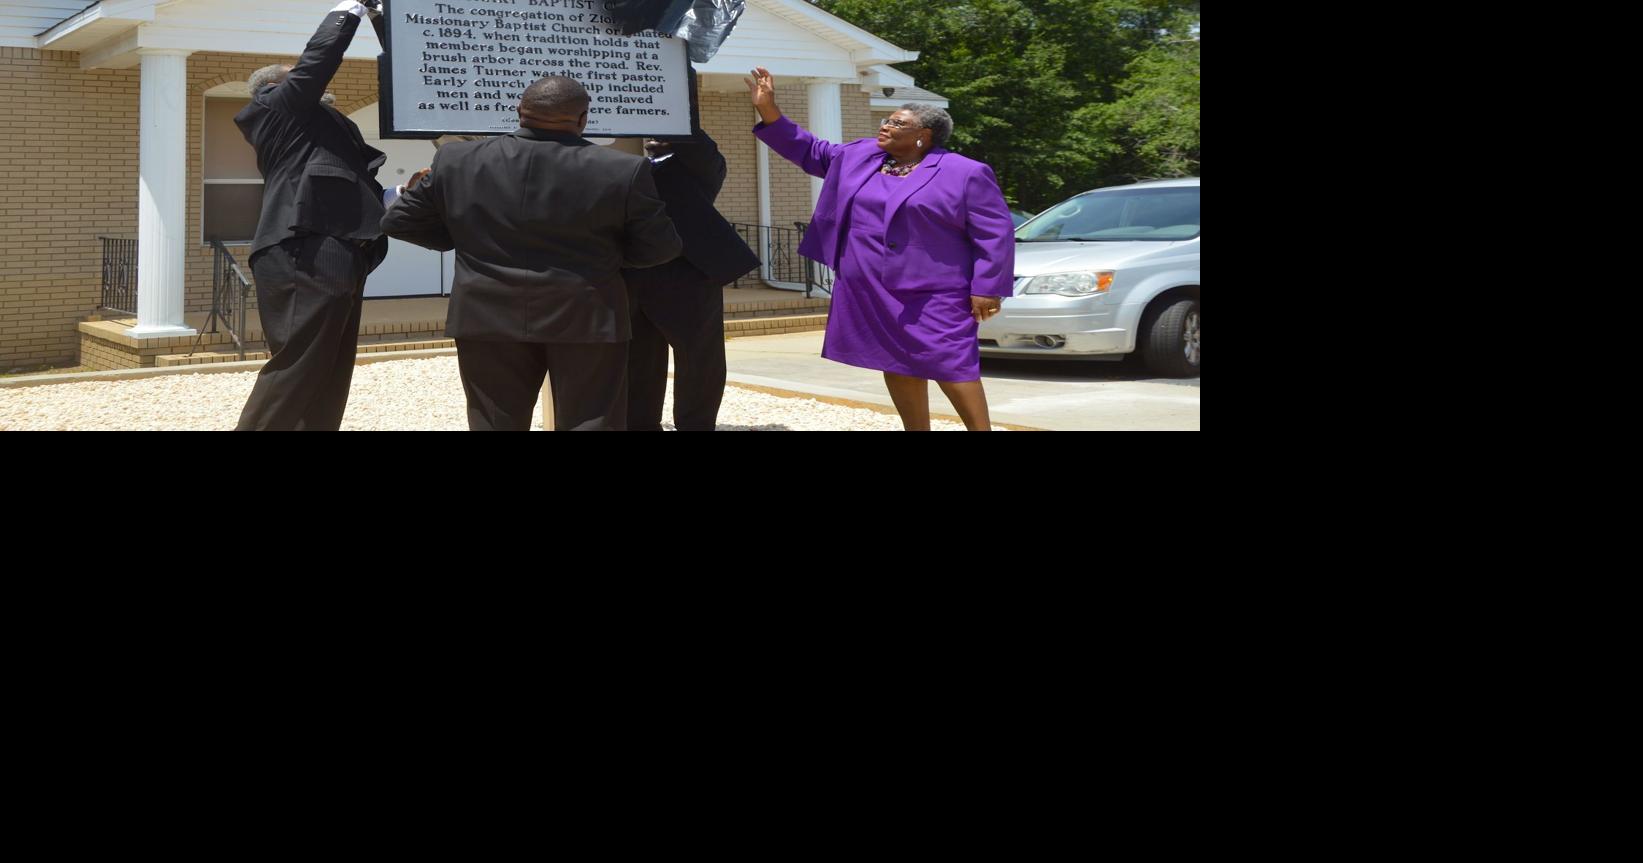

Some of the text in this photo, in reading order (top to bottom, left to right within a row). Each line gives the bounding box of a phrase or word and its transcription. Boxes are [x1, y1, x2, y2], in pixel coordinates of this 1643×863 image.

[435, 3, 617, 24] The congregation of Zio
[405, 14, 490, 29] Missionary
[495, 18, 547, 32] Baptist
[551, 22, 600, 35] Church
[484, 31, 520, 42] when
[525, 34, 589, 45] tradition
[593, 37, 629, 48] holds
[634, 40, 660, 49] that
[426, 41, 659, 60] members began worshipping at a
[422, 51, 663, 71] brush arbor across the road. Rev.
[419, 63, 666, 83] James Turner was the first pastor.
[423, 75, 467, 88] Early
[474, 78, 526, 89] church
[608, 83, 664, 94] included
[437, 90, 468, 99] men
[474, 89, 501, 100] and
[597, 94, 653, 104] enslaved
[418, 102, 435, 111] as
[440, 101, 469, 111] well
[474, 104, 490, 112] as
[616, 106, 670, 116] farmers.
